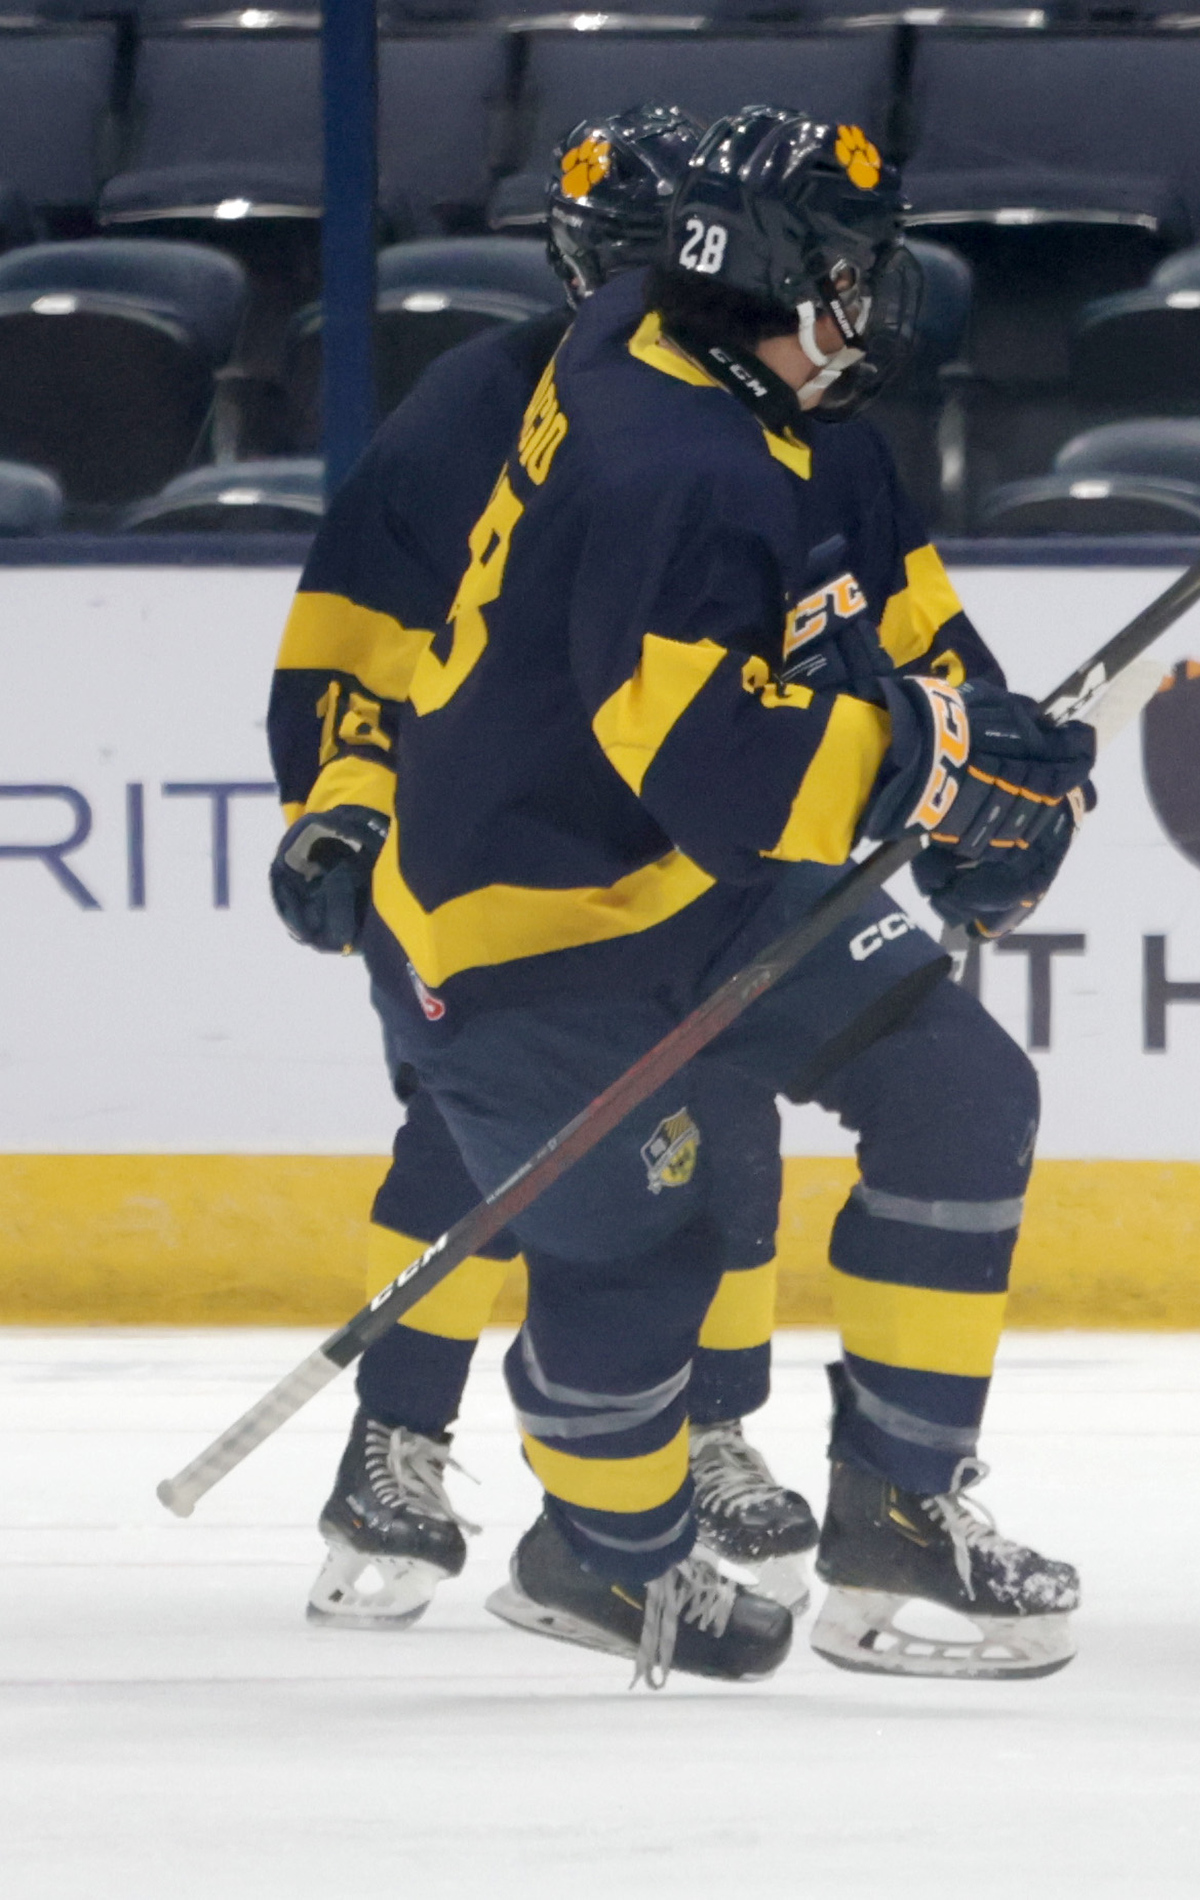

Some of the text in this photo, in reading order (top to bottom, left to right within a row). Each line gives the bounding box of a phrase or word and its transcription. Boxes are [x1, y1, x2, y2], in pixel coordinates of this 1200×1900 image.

[679, 218, 728, 274] 28
[708, 347, 768, 398] CCM
[408, 460, 525, 718] 8
[849, 912, 916, 961] CC
